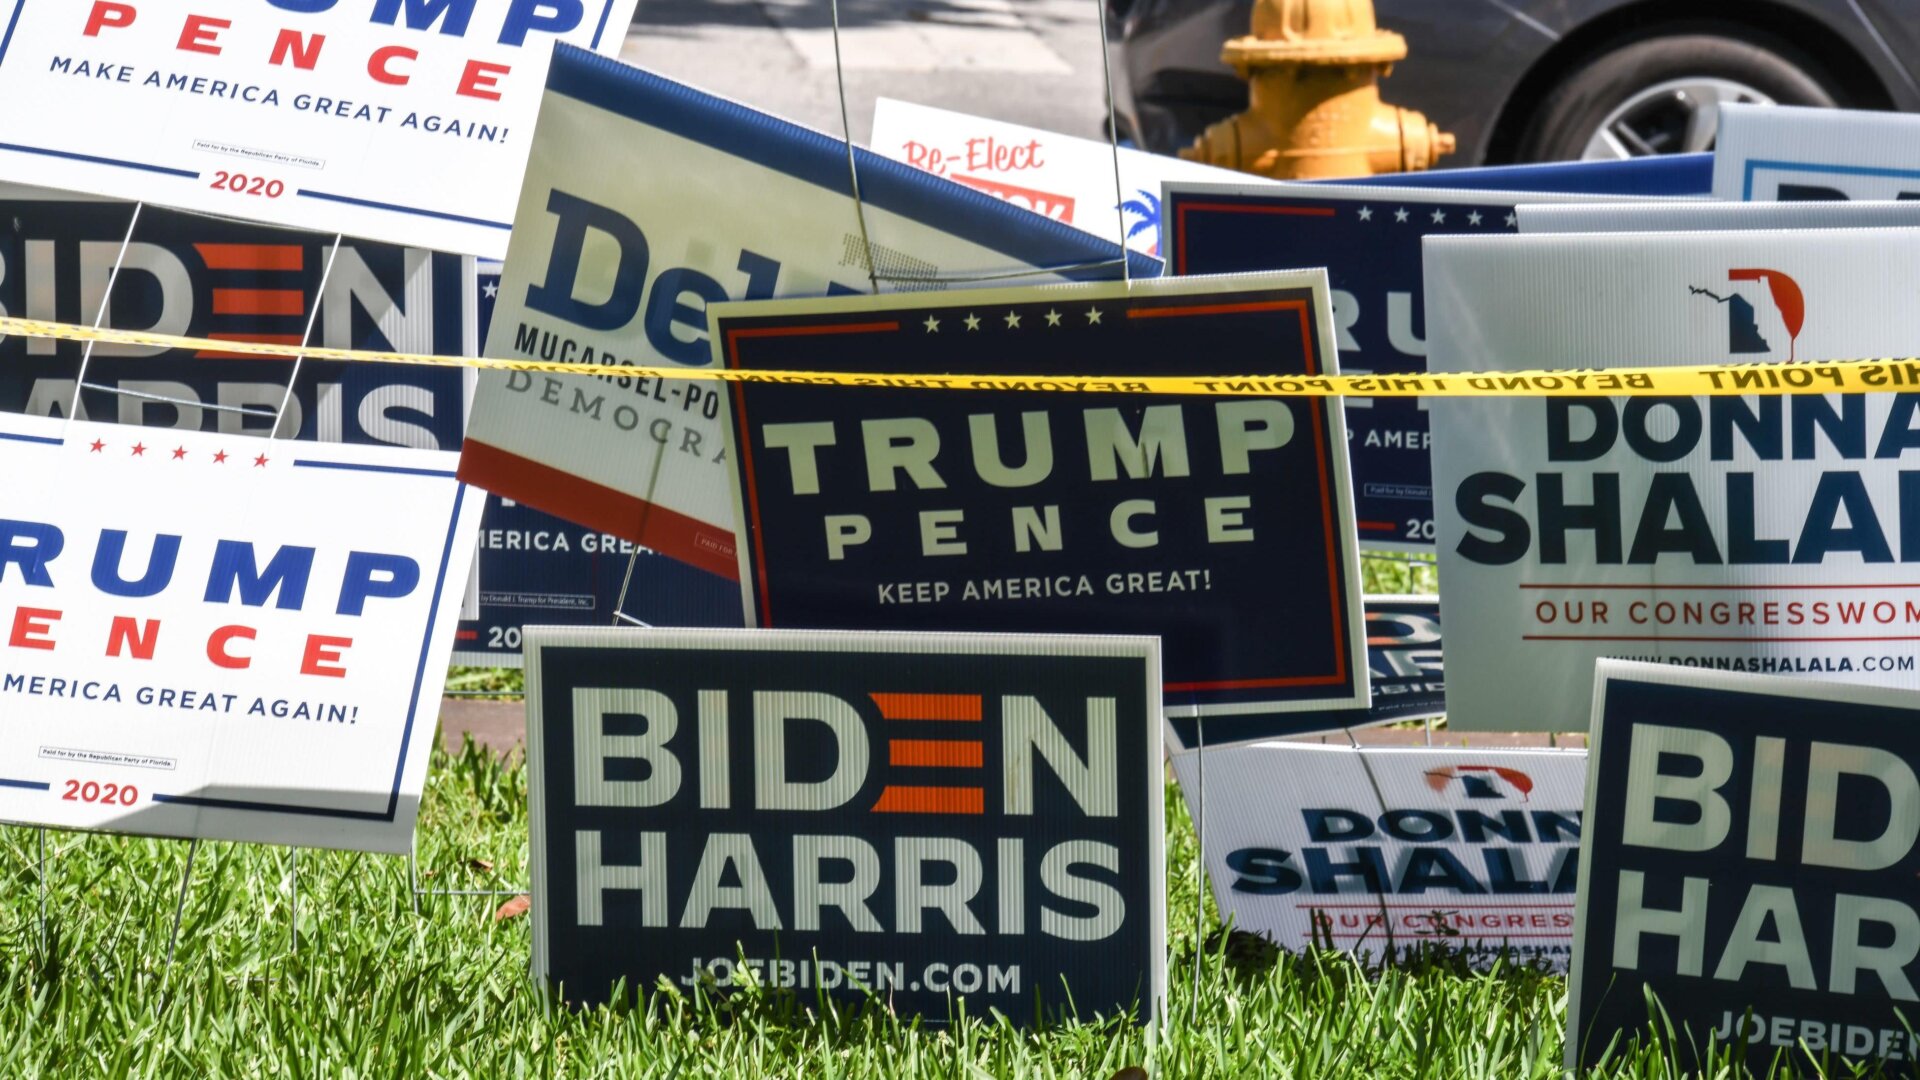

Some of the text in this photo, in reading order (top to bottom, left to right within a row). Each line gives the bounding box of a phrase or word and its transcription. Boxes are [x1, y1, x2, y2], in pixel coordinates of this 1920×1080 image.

[82, 2, 511, 101] PENCE
[50, 56, 510, 144] MAKE AMERICA GREAT AGAIN!
[210, 171, 284, 198] 2020
[902, 136, 1045, 175] Re-Elect
[0, 240, 433, 360] IDEN
[514, 322, 719, 421] MUCARSEL-PO
[762, 400, 1295, 494] TRUMP
[581, 533, 662, 556] GRE
[824, 496, 1254, 560] PENCE
[1406, 518, 1435, 539] 20
[0, 519, 420, 617] RUMP
[878, 569, 1212, 605] KEEP AMERICA GREAT!
[8, 606, 353, 678] ENCE
[488, 626, 522, 648] 20
[1536, 600, 1920, 626] OUR CONGRESSWOM
[3, 673, 359, 724] MERICA GREAT AGAIN!
[573, 687, 1119, 818] BIDEN
[62, 779, 138, 806] 2020
[1622, 722, 1920, 871] BID
[1300, 808, 1582, 843] DONN
[575, 830, 1127, 942] HARRIS
[1403, 912, 1574, 930] CONGRES
[1612, 868, 1920, 1003] HAR
